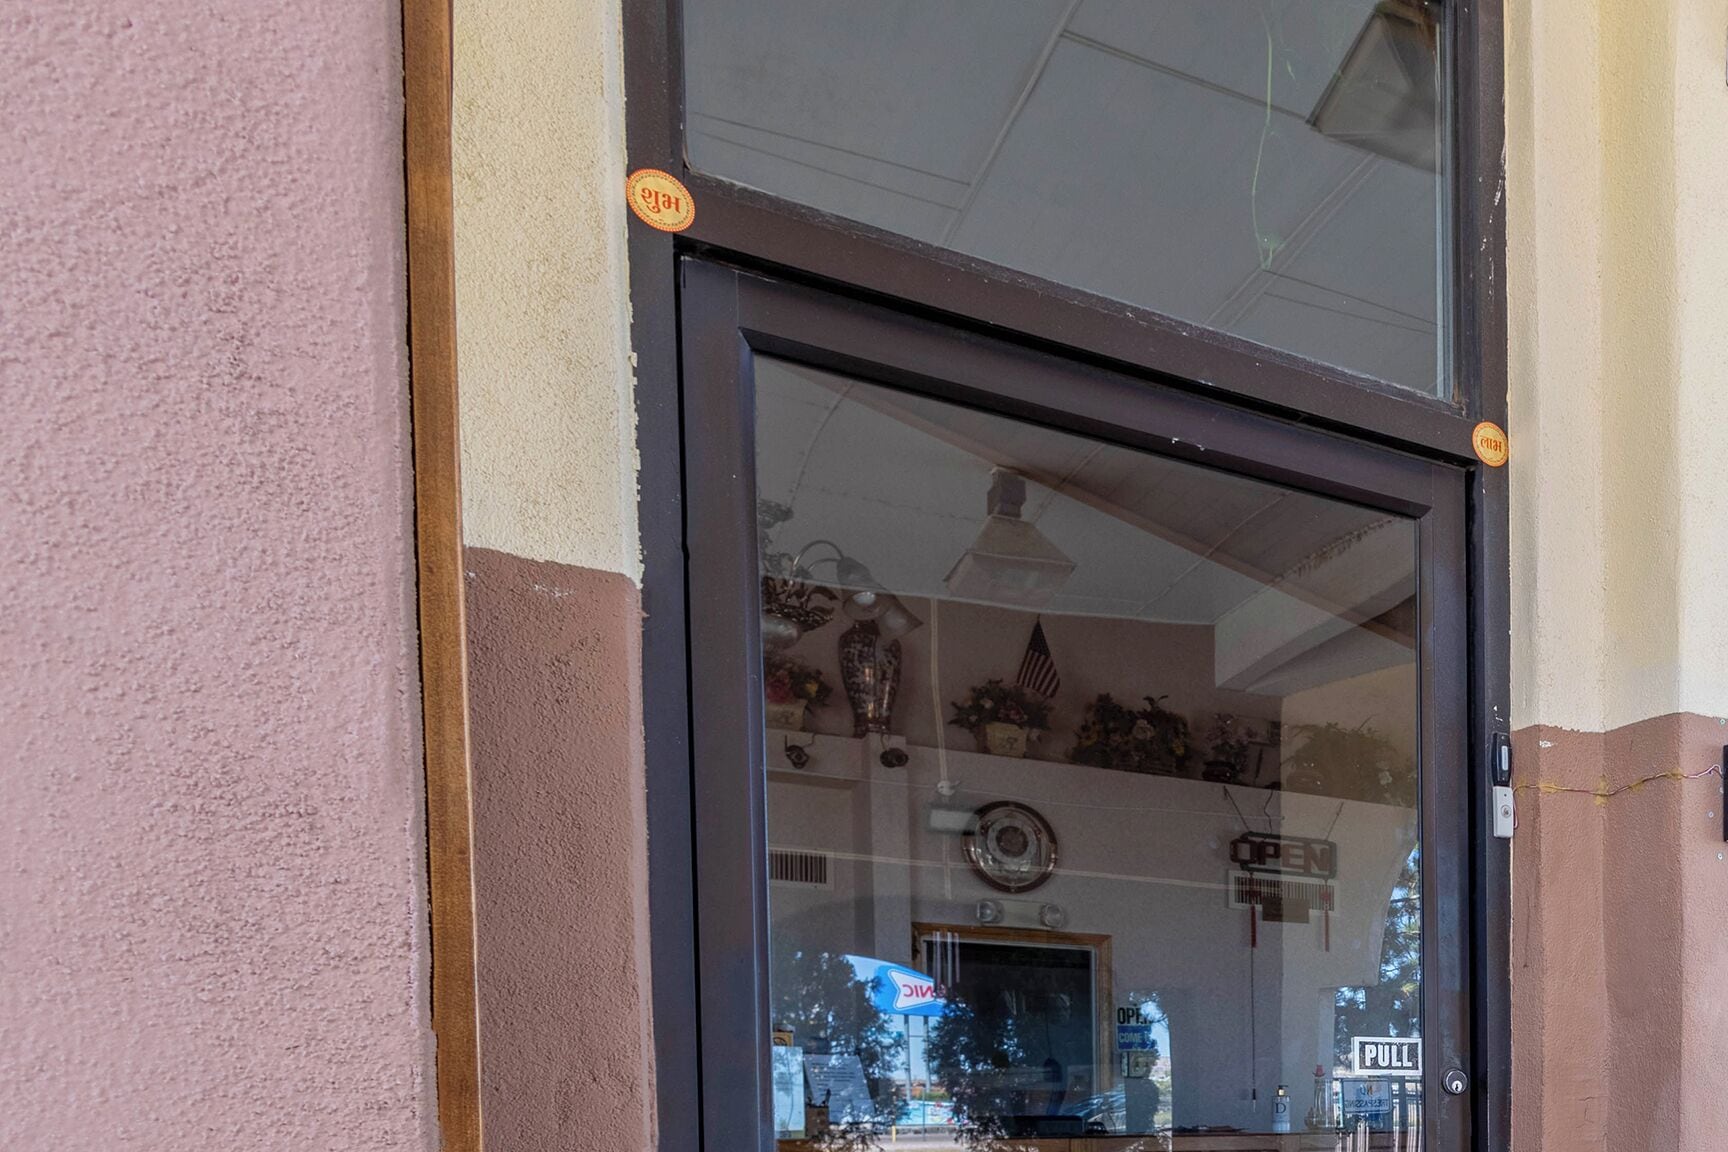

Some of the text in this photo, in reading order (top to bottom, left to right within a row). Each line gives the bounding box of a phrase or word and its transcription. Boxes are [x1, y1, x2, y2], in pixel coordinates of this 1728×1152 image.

[641, 187, 681, 214] શુભ
[1230, 839, 1330, 873] OPEN
[1365, 1044, 1413, 1067] PULL
[1275, 1102, 1287, 1114] D
